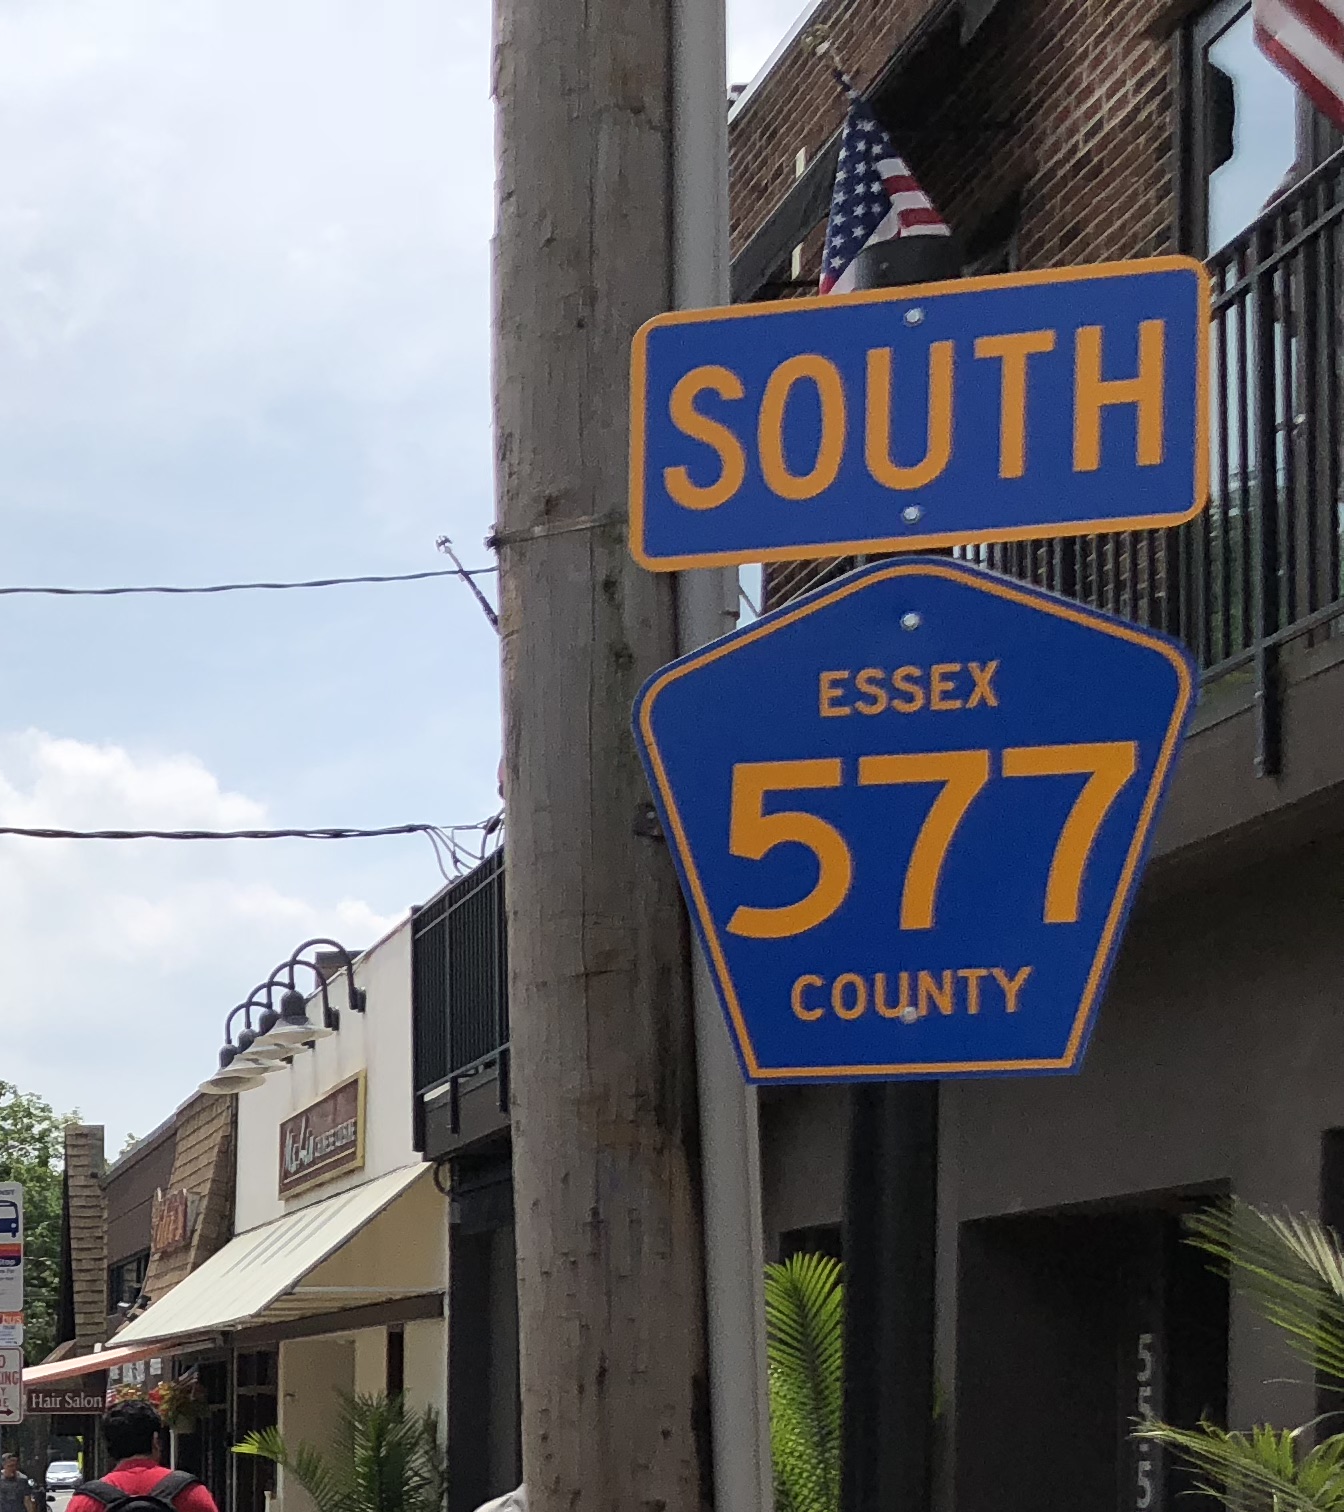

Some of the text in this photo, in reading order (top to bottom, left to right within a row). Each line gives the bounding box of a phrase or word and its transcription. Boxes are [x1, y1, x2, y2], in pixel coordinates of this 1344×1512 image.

[663, 318, 1165, 511] SOUTH
[818, 660, 1000, 717] ESSEX
[726, 741, 1139, 939] 577
[791, 966, 1033, 1021] COUNTY
[31, 1391, 103, 1409] Hair Salon
